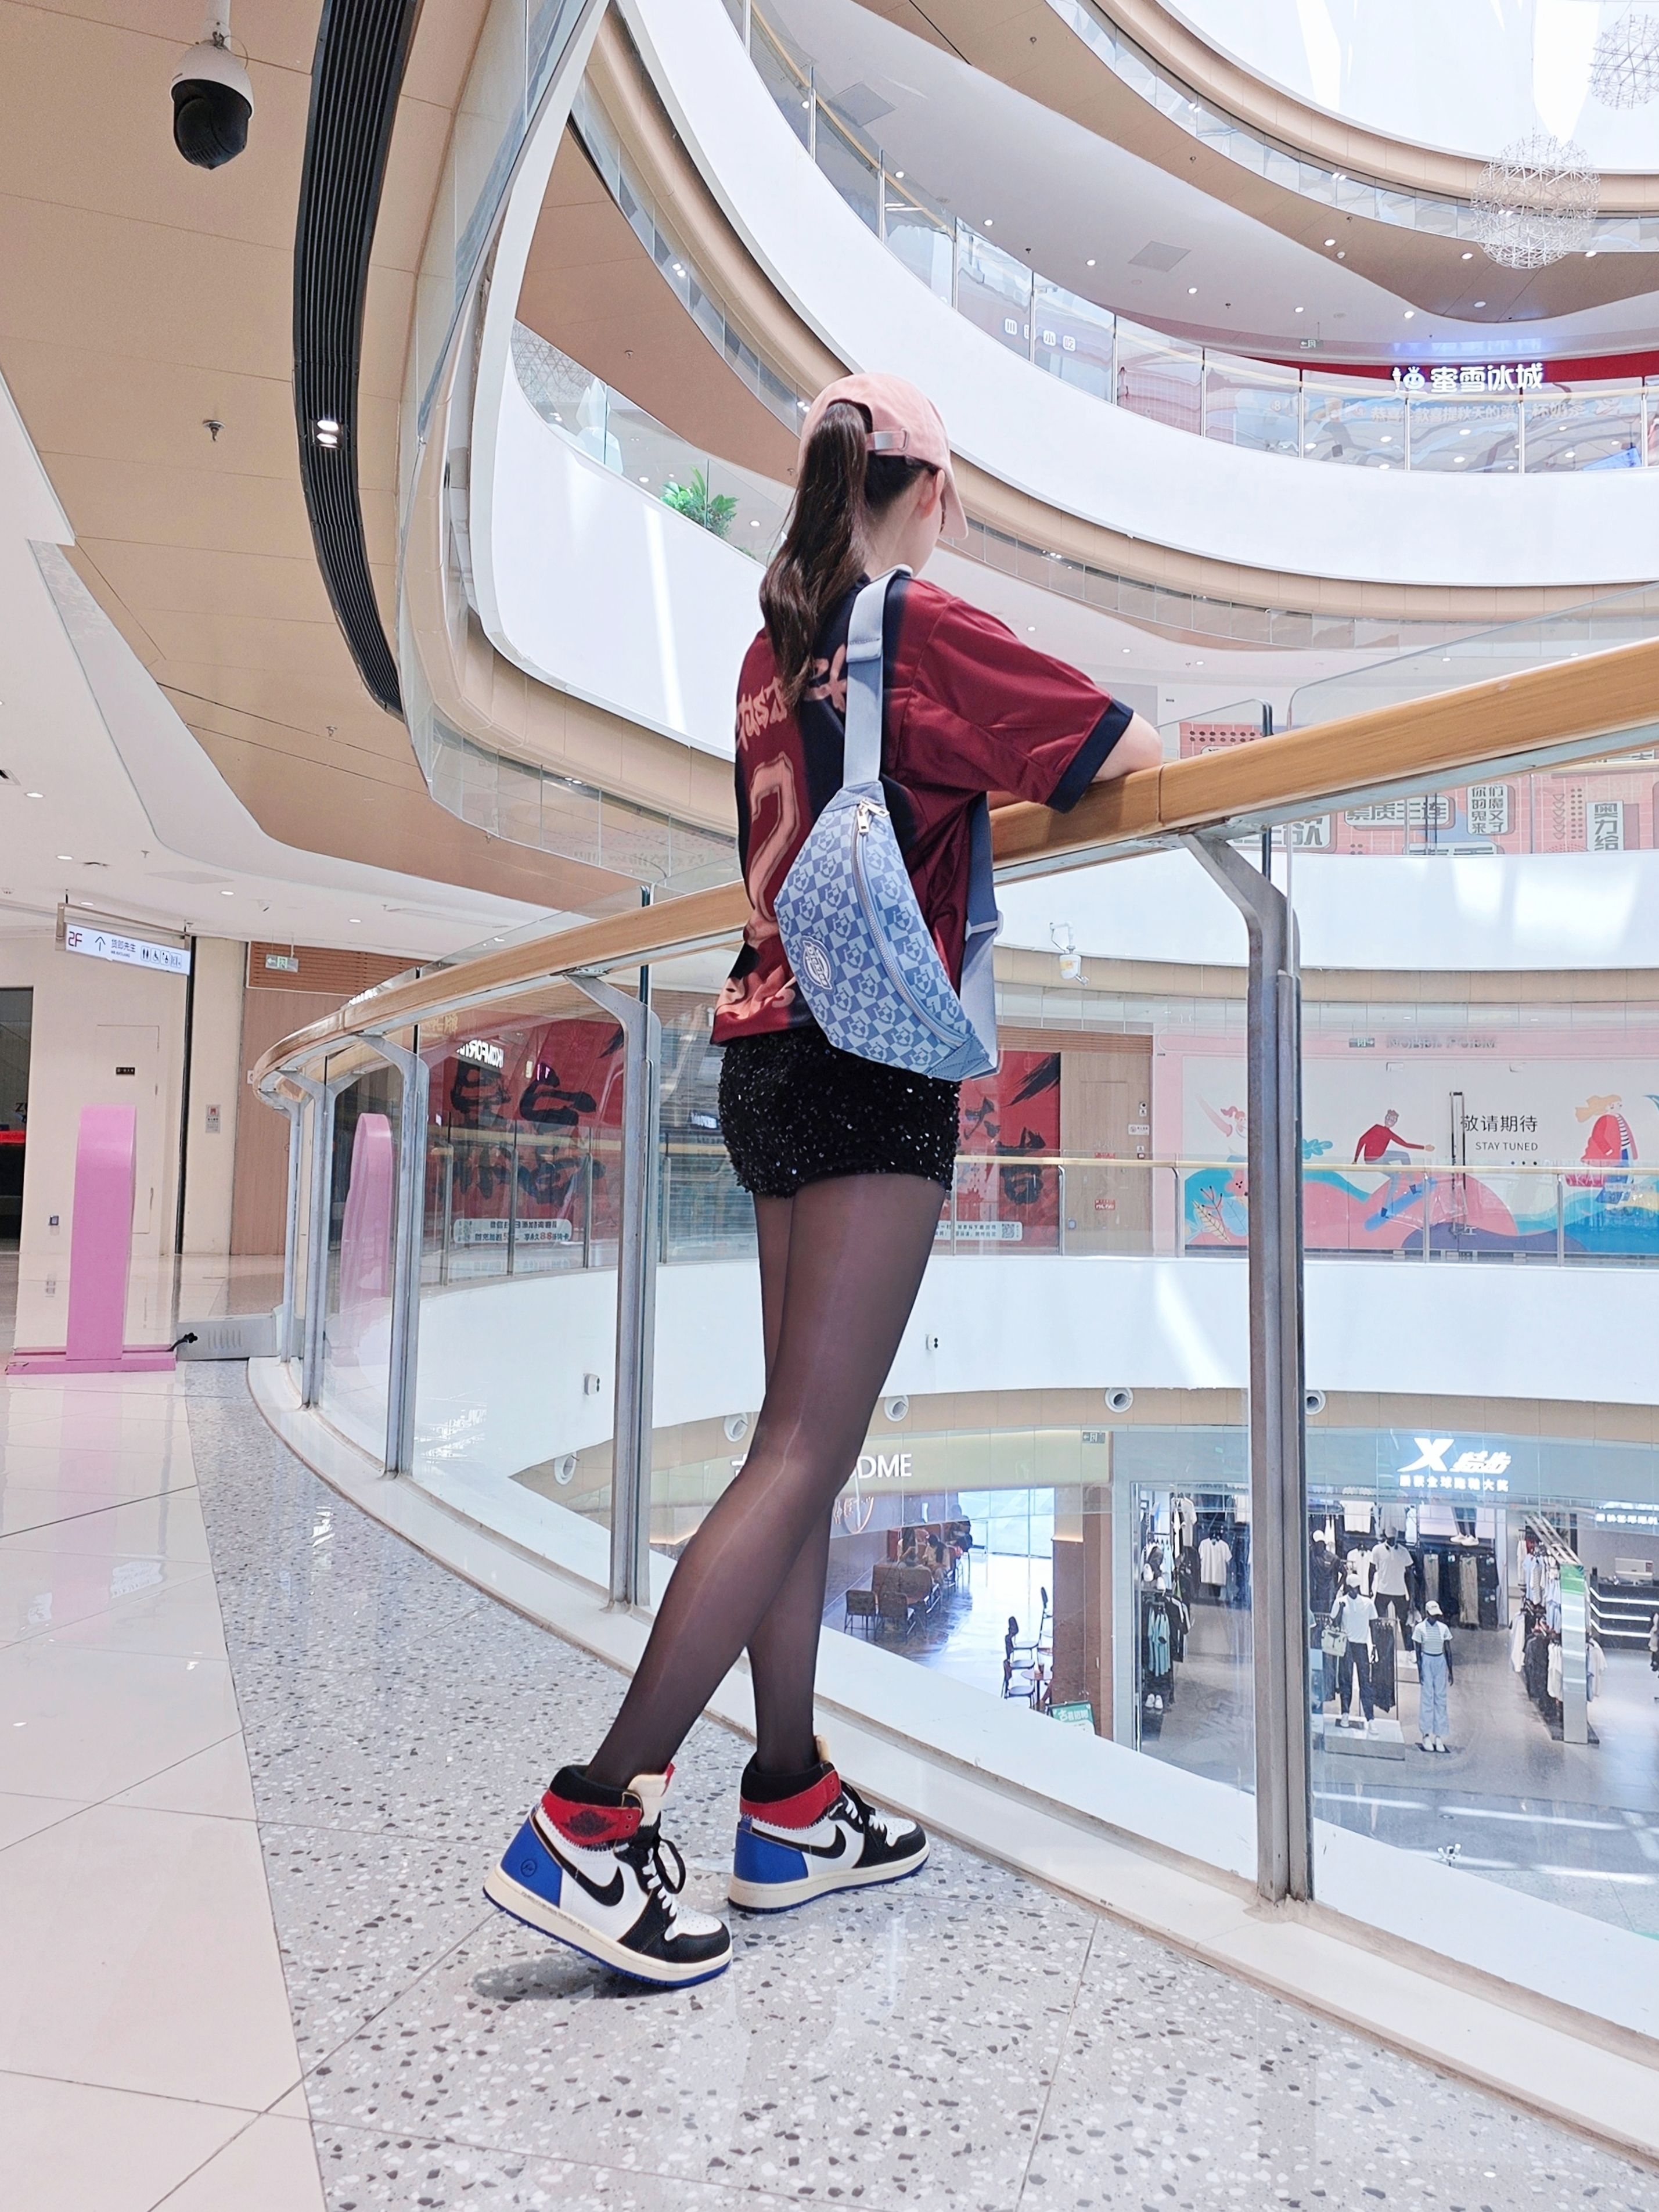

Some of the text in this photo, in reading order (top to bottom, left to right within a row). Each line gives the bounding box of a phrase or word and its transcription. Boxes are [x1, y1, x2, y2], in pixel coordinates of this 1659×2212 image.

[1430, 362, 1543, 393] 蜜雪冰城
[1595, 803, 1619, 851] 奥力给
[68, 931, 82, 947] 2F
[1460, 1114, 1538, 1132] 敬请期待
[1476, 1142, 1538, 1151] STAY TUNED
[849, 1453, 912, 1480] DME
